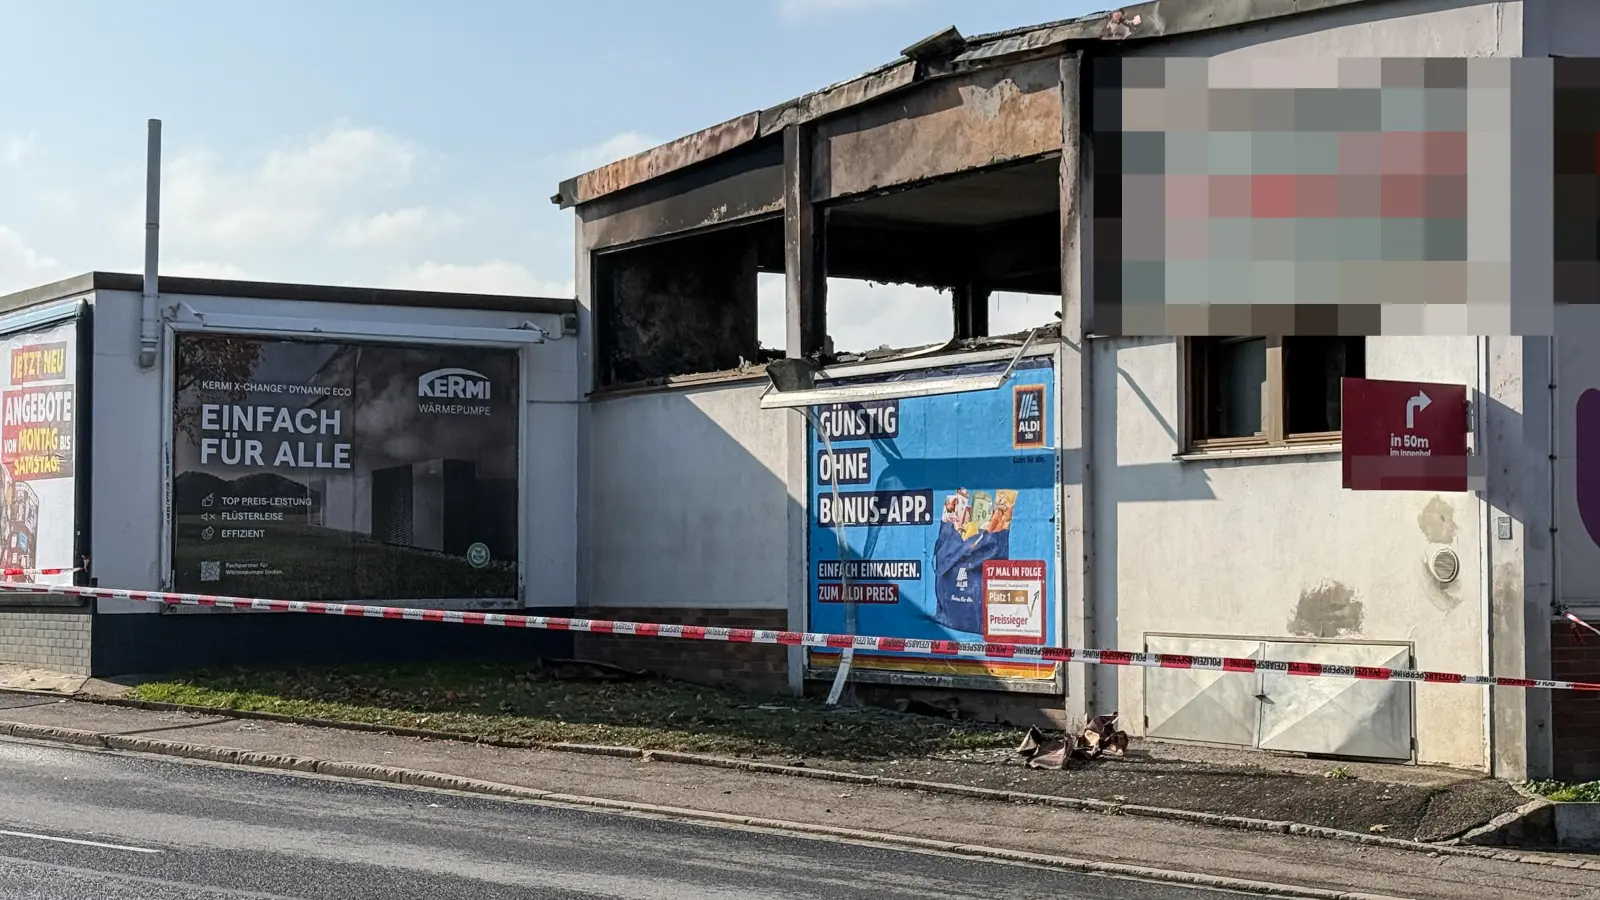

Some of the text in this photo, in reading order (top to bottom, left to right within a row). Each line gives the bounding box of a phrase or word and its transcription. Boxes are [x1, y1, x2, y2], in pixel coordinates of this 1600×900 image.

[13, 348, 64, 379] JETZT NEU
[202, 381, 232, 390] KERMI
[289, 385, 330, 396] DYNAMIC
[332, 388, 352, 397] ECO
[418, 368, 491, 400] KERMI
[4, 391, 72, 426] ANGEBOTE
[418, 402, 491, 416] WÄRMEPUMPE
[202, 404, 340, 435] EINFACH
[820, 404, 896, 436] GÜNSTIG
[1018, 420, 1040, 432] ALDI
[4, 427, 70, 454] VON MONTAG BIS
[1390, 432, 1429, 448] in 50m
[201, 432, 350, 468] FÜR ALLE
[820, 453, 868, 480] OHNE
[221, 496, 312, 506] TOP PREIS-LEISTUNG
[221, 510, 284, 520] FLÜSTERLEISE
[820, 496, 930, 523] BONUS-APP.
[221, 529, 266, 538] EFFIZIENT
[819, 562, 920, 577] EINFACH EINKAUFEN.
[986, 566, 1042, 576] 17 MAL IN FOLGE
[819, 586, 838, 600] ZUM
[866, 586, 898, 601] PREIS.
[990, 592, 1006, 602] Platz
[990, 614, 1028, 628] Preissieger
